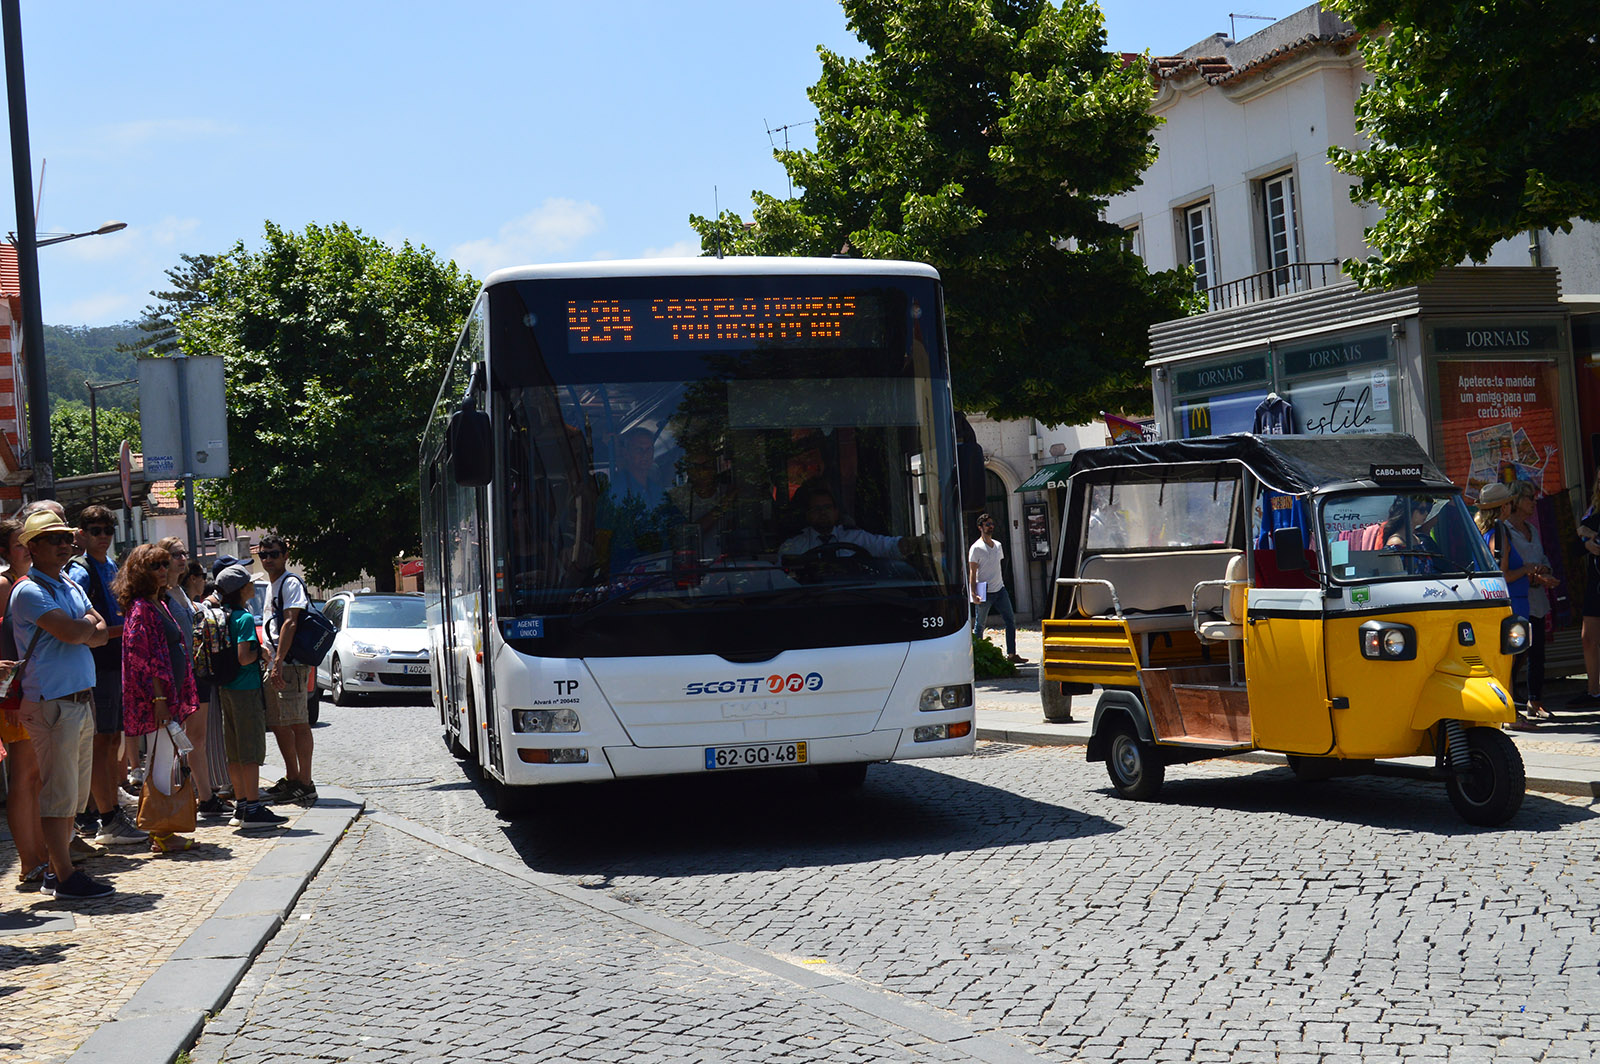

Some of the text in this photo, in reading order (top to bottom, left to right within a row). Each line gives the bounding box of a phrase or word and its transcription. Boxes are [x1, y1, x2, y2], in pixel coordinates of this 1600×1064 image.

[651, 297, 756, 320] CASTELO
[568, 300, 634, 342] 434
[1465, 330, 1531, 347] JORNAIS
[1308, 344, 1362, 369] JORNAIS
[1198, 365, 1245, 387] JORNAIS
[1505, 376, 1536, 387] mandar
[1460, 391, 1537, 406] um amigo para um
[1306, 386, 1376, 434] estilo
[1478, 406, 1499, 418] certo
[1047, 480, 1069, 489] BA
[1480, 579, 1502, 591] Tuk
[517, 620, 539, 628] AGENTE
[922, 616, 944, 628] 539
[408, 665, 427, 673] 4024
[553, 680, 579, 695] TP
[686, 672, 823, 695] SCOTTURB
